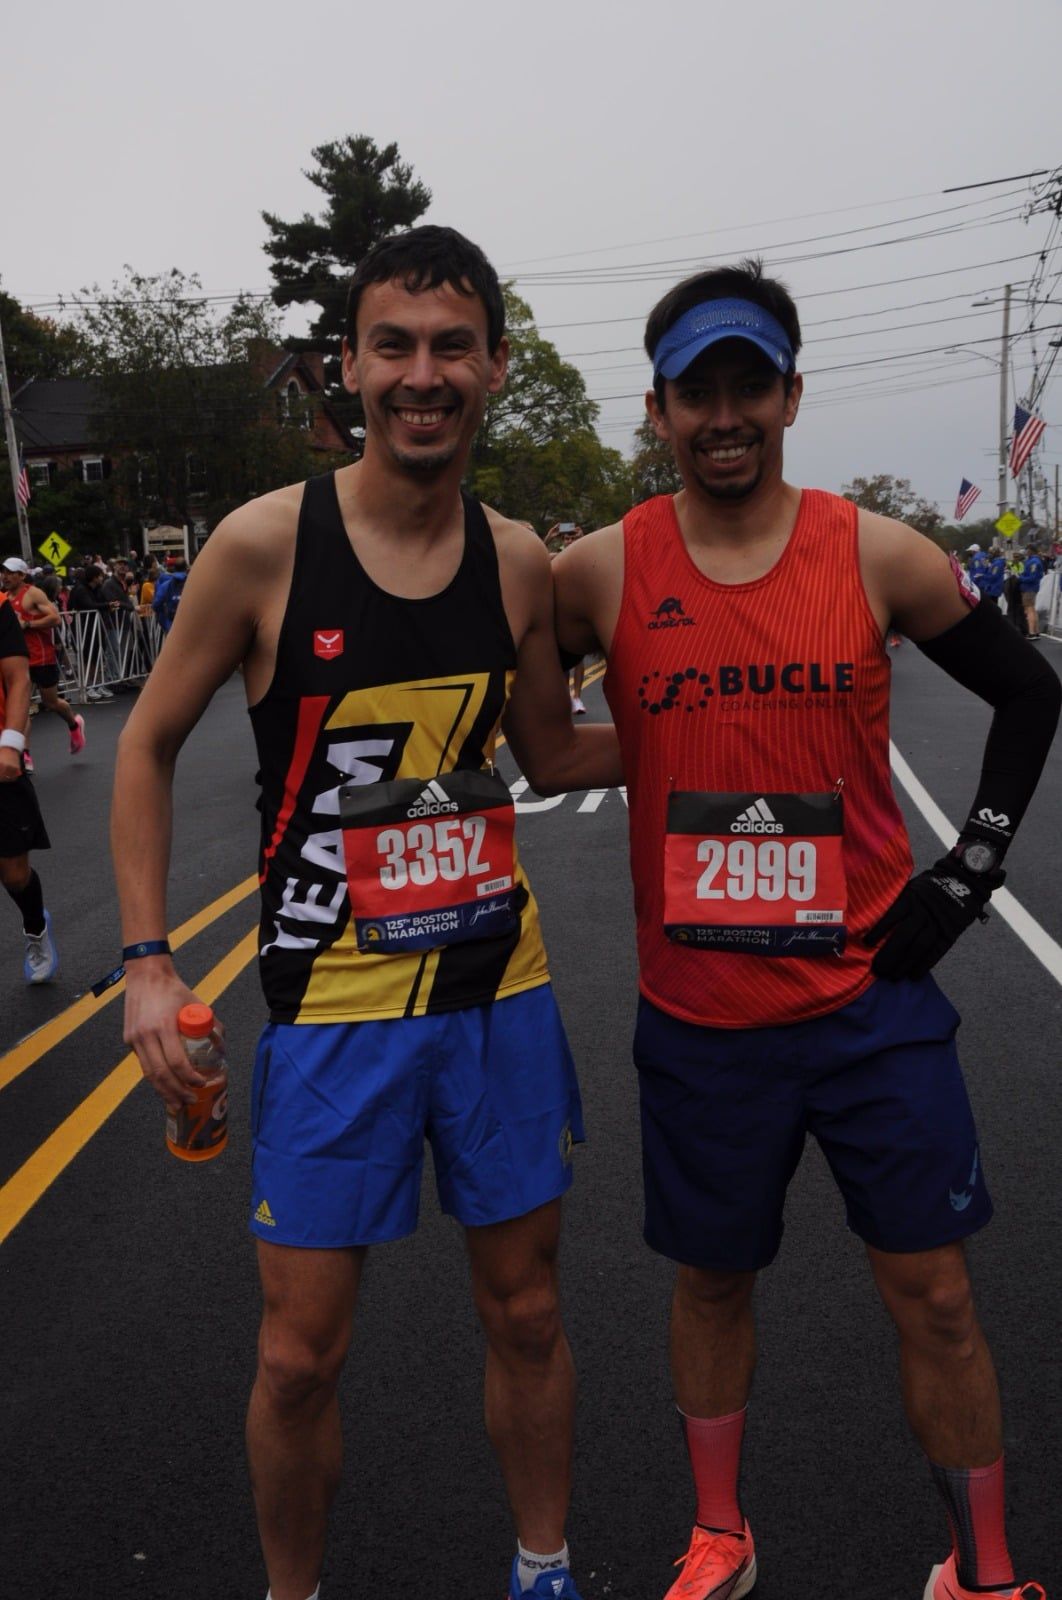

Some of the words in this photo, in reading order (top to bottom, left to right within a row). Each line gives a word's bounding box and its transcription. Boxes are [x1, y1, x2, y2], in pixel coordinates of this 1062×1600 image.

[719, 663, 854, 696] BUCLE
[720, 698, 801, 712] COACHING
[406, 800, 459, 819] adidas
[730, 820, 784, 835] adidas
[376, 817, 490, 889] 3352
[696, 840, 817, 903] 2999
[412, 910, 458, 927] BOSTON
[388, 919, 459, 941] MARATHON
[723, 929, 770, 938] BOSTON
